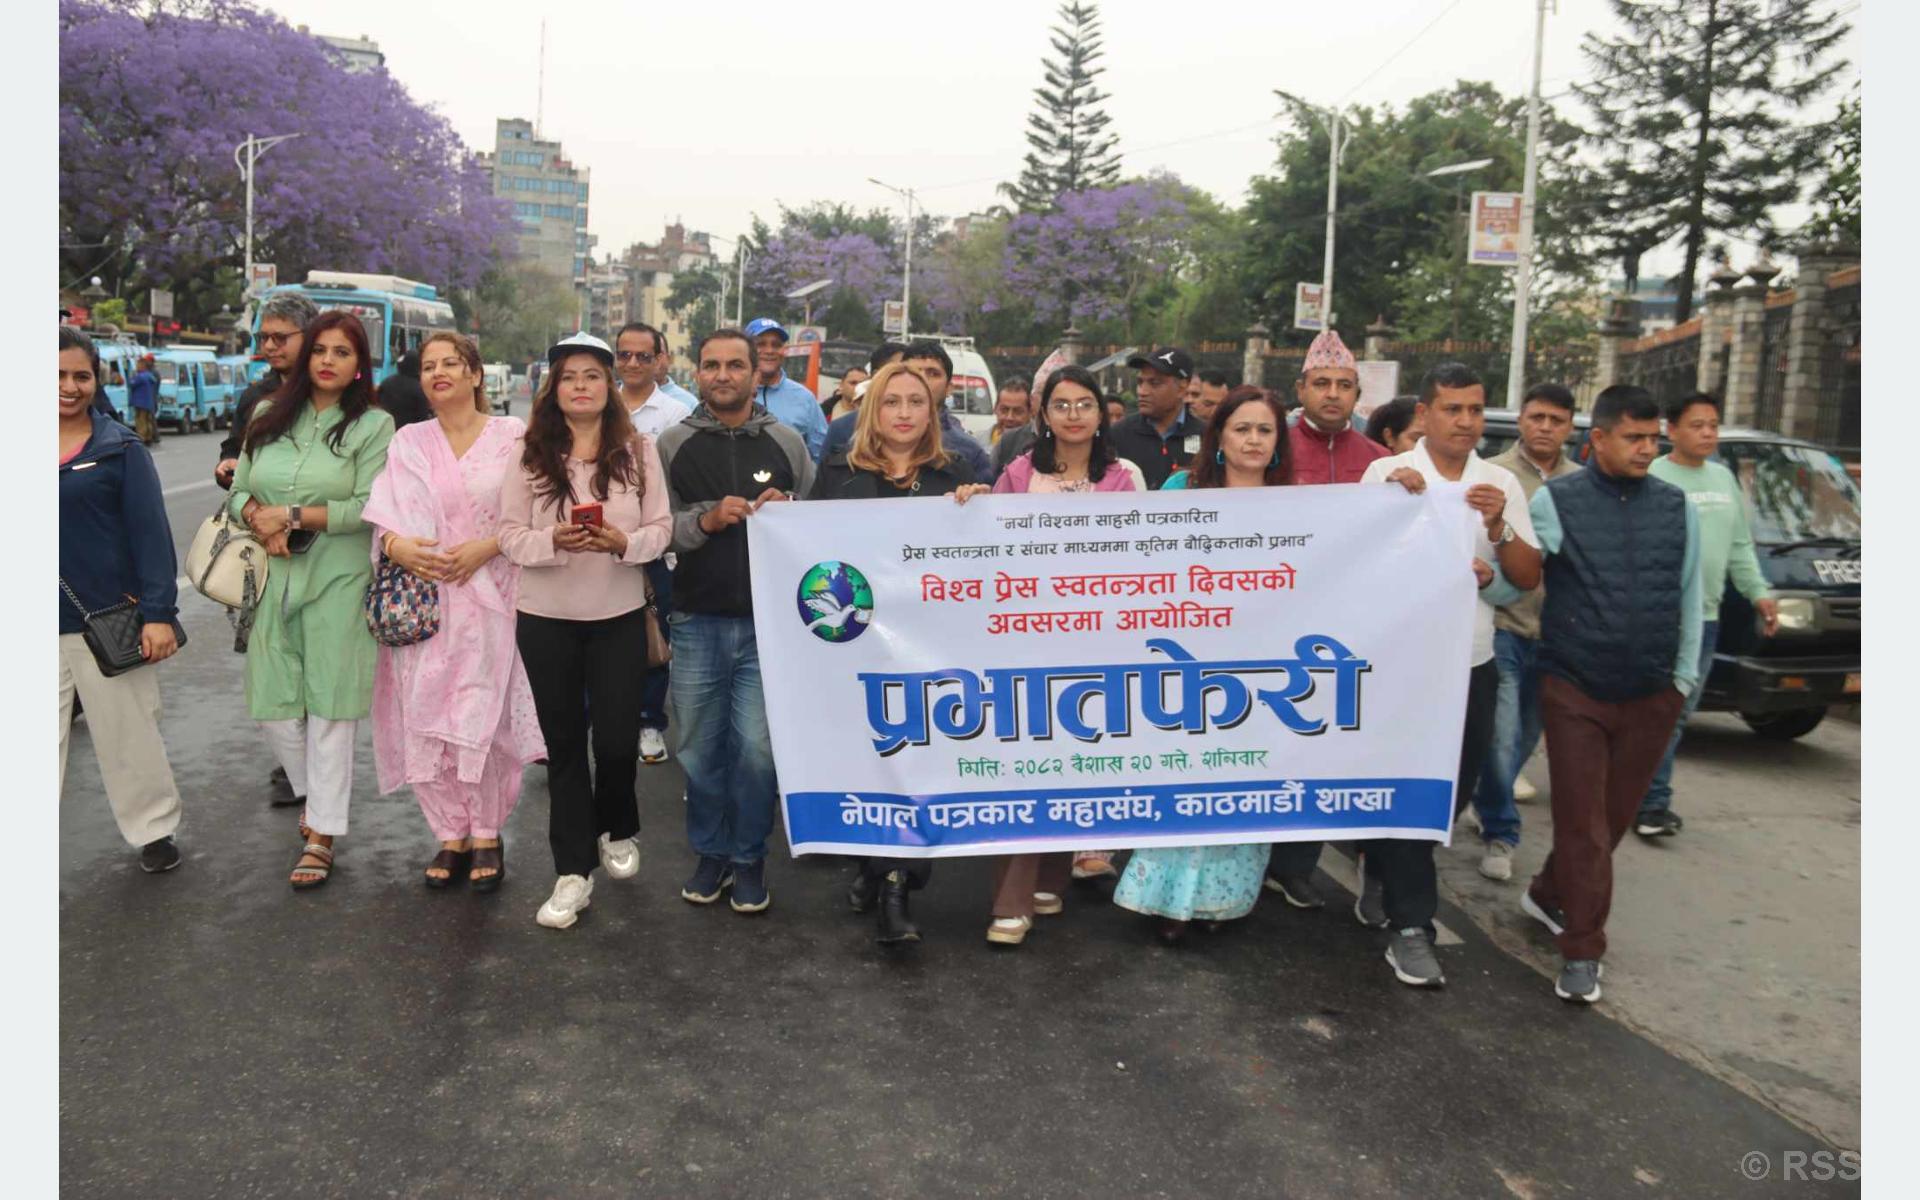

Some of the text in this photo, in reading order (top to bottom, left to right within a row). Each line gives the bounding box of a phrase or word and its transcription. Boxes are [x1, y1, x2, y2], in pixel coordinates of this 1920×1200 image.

[1039, 513, 1089, 529] विश्वमा
[1096, 510, 1140, 529] साहसी
[1146, 508, 1219, 526] पत्रकारिता
[902, 544, 926, 561] प्रेस
[932, 545, 999, 559] स्वतन्त्रता
[1005, 544, 1014, 557] र
[1021, 541, 1058, 556] संचार
[1064, 540, 1129, 555] माध्यममा
[921, 563, 1297, 602] विश्व प्रेस स्वतन्त्रता दिवसको
[987, 601, 1234, 634] अवसरमा आयोजित
[857, 634, 1372, 758] प्रभातफेरी
[1014, 757, 1064, 778] २०८२
[1131, 755, 1152, 773] २०
[1202, 748, 1269, 771] शनिवार
[840, 780, 1396, 829] नेपाल पत्रकार महासंघ, काठमाडौं शाखा
